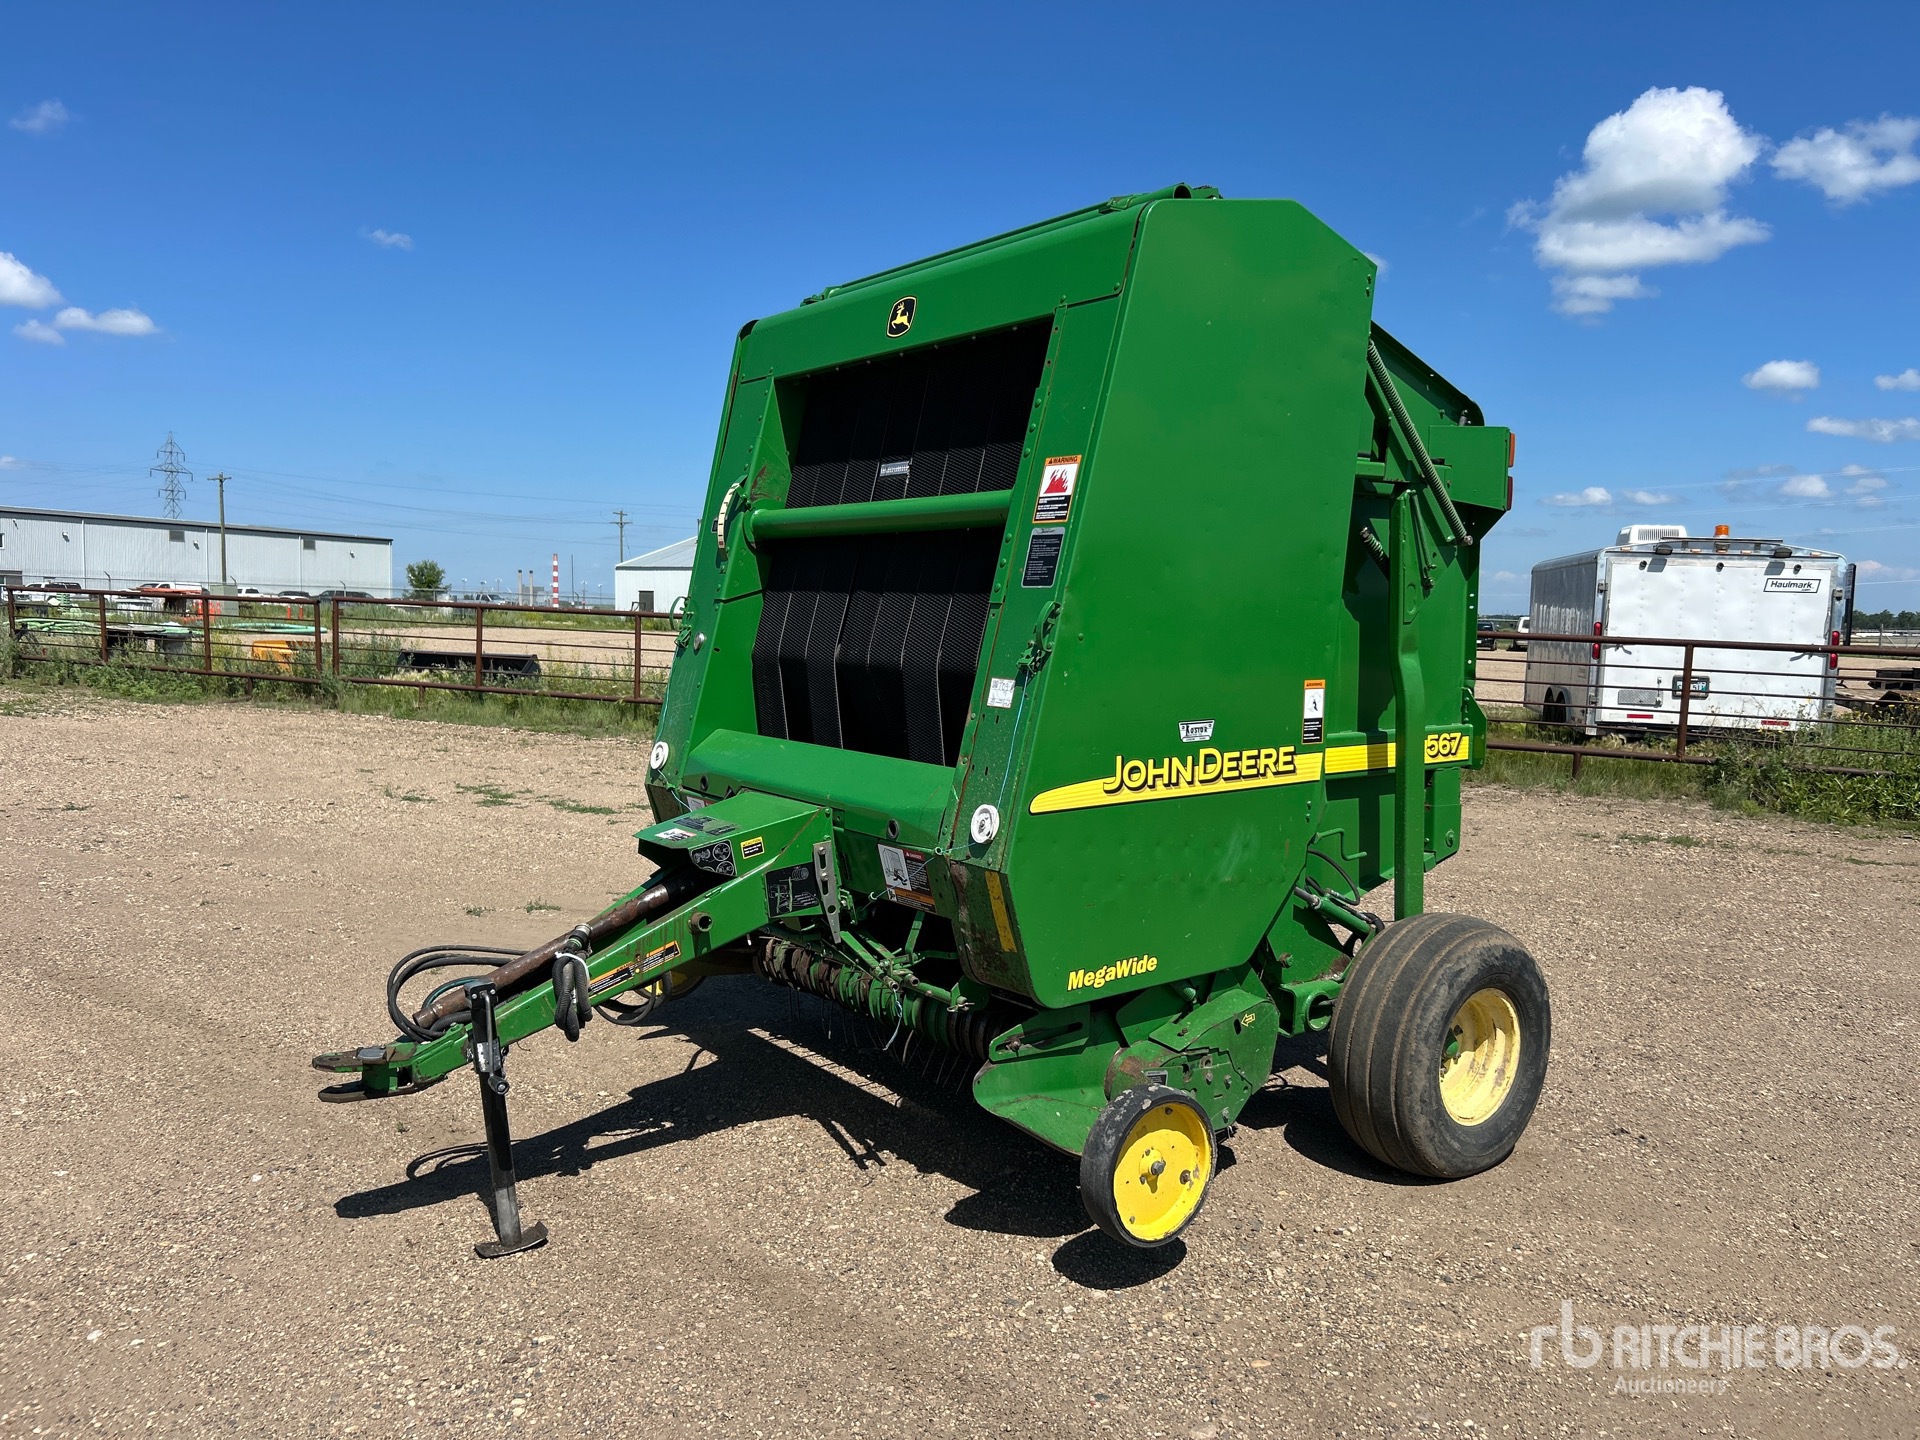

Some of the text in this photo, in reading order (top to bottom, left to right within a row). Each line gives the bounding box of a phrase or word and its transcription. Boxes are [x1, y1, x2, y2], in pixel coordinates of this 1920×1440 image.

[1053, 455, 1078, 464] WARNING
[1770, 580, 1812, 589] Haulmark
[1426, 732, 1462, 758] 567
[1103, 746, 1296, 794] JOHN DEERE
[1067, 954, 1158, 991] MegaWide
